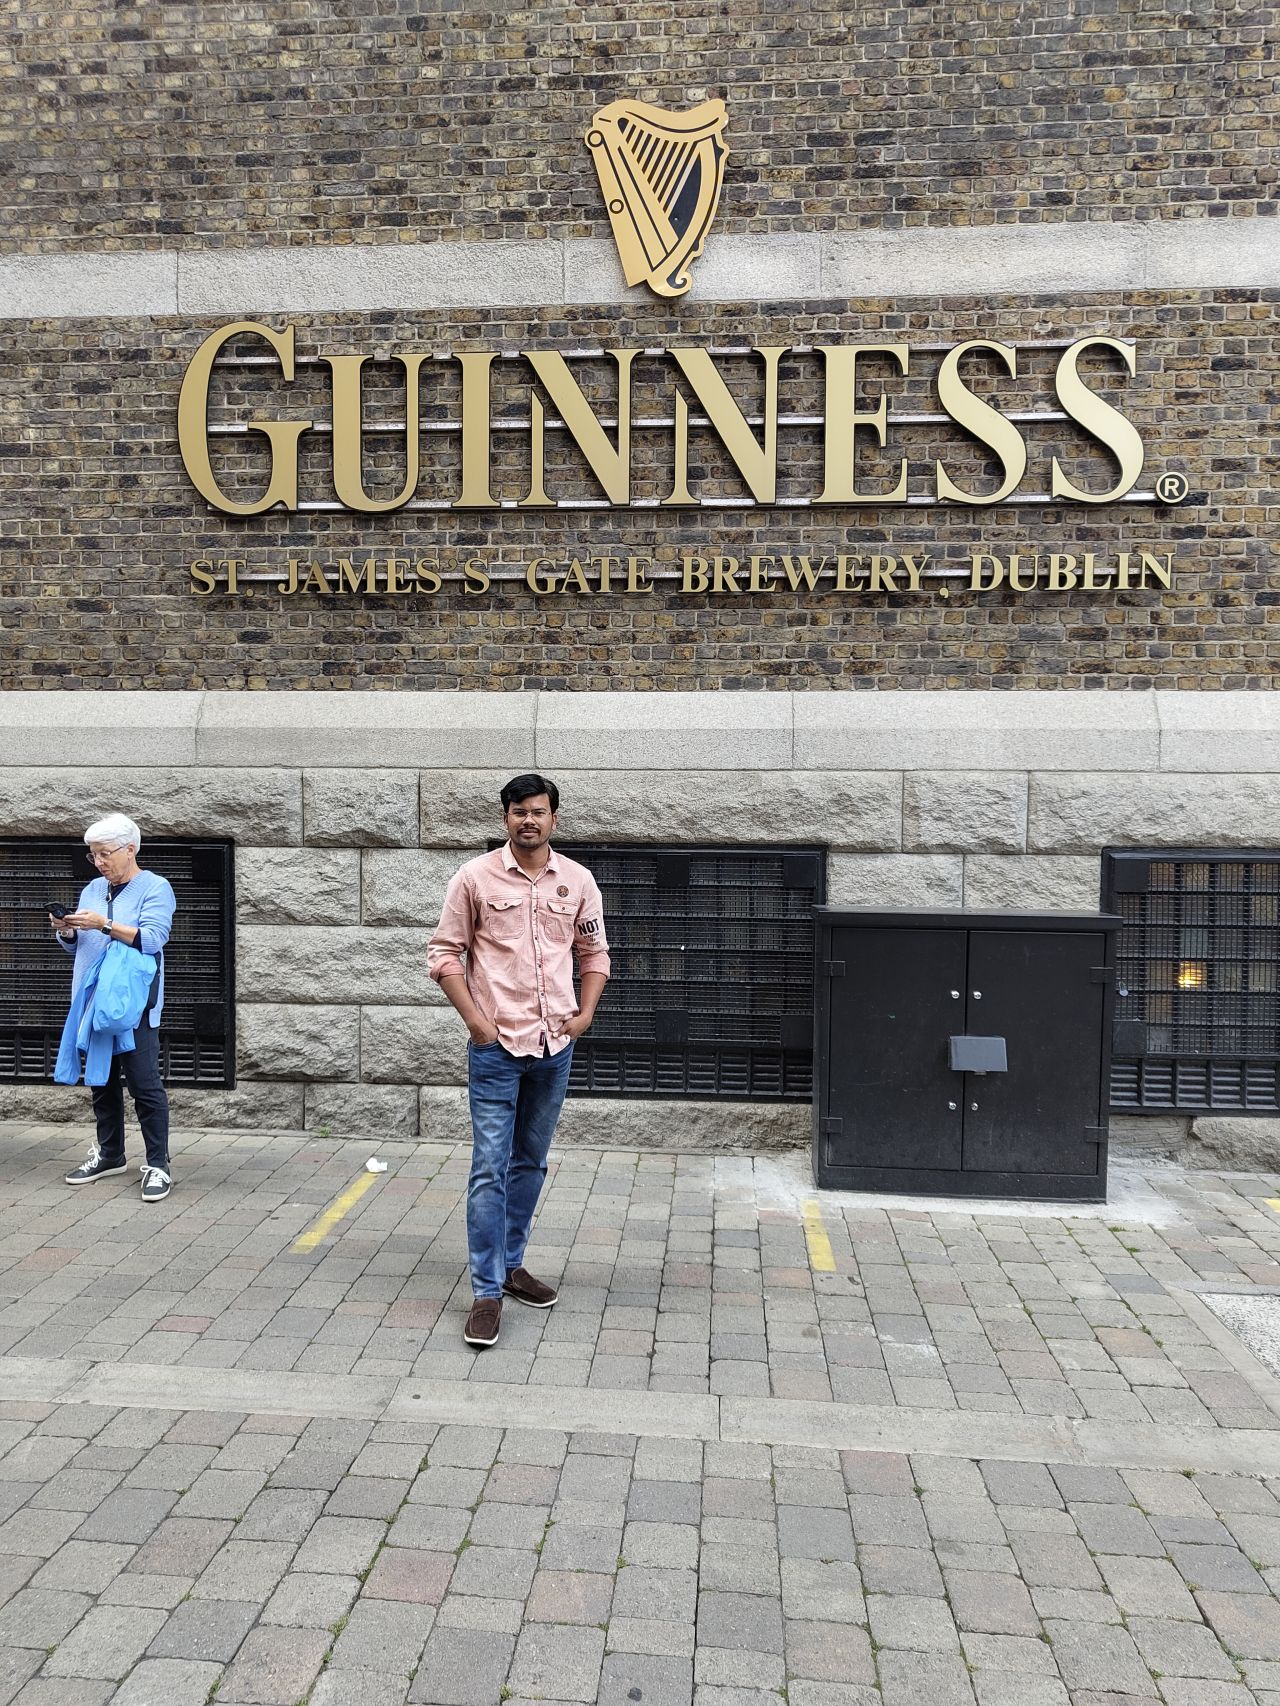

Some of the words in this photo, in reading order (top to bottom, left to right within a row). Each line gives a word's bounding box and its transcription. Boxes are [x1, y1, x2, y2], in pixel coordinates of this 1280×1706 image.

[177, 320, 1145, 515] GUINNESS
[189, 558, 254, 598] ST.
[526, 556, 653, 594] GATE
[968, 552, 1174, 592] DUBLIN
[577, 918, 600, 935] NOT
